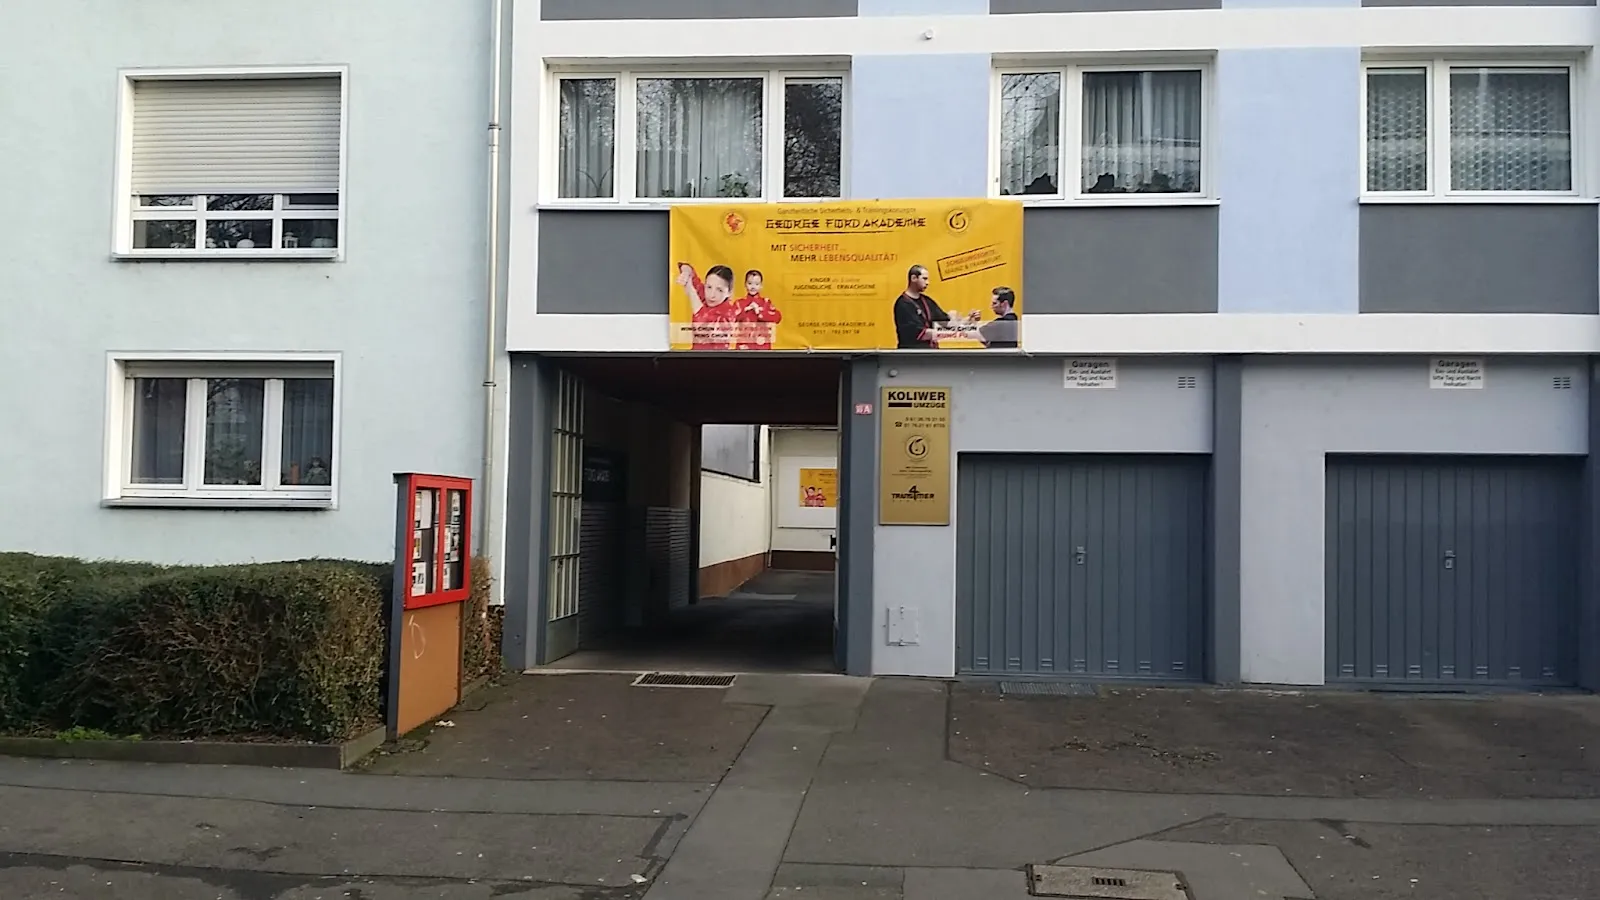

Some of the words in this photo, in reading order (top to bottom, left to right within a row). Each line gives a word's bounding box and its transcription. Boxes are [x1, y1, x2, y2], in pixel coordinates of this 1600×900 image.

[765, 219, 820, 229] GEORGE
[825, 218, 860, 229] FORD
[862, 217, 926, 228] AKADEMIE
[771, 244, 787, 252] MIT
[790, 254, 817, 262] MEHR
[1071, 360, 1110, 369] Garagen
[1438, 360, 1477, 369] Garagen
[887, 391, 946, 401] KOLIWER
